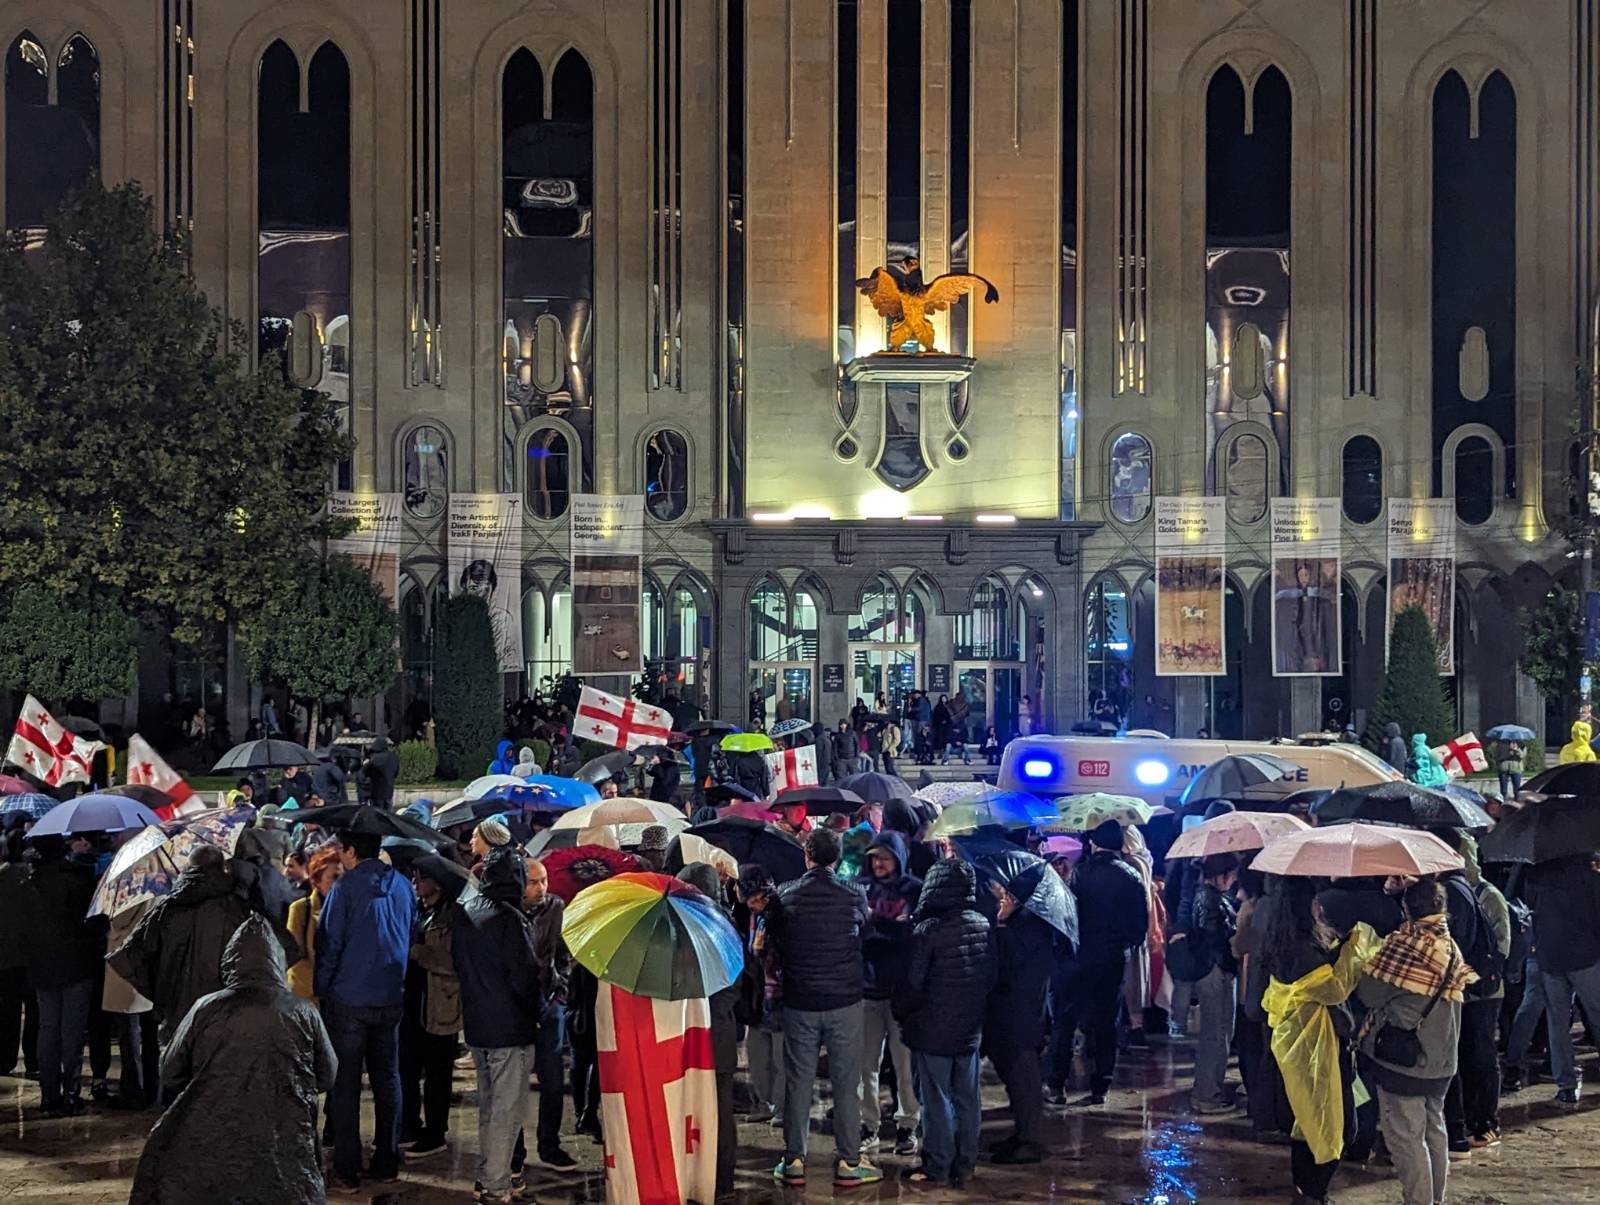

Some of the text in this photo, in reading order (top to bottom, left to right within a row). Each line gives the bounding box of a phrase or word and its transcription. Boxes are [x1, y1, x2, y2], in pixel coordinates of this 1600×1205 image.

[348, 499, 380, 508] Largest
[386, 514, 399, 522] Art
[451, 513, 499, 521] The Artistic
[574, 515, 593, 523] Born
[1158, 517, 1208, 526] King Tamar's
[451, 522, 487, 531] Diversity
[574, 532, 606, 542] Georgia
[1094, 762, 1108, 775] 112
